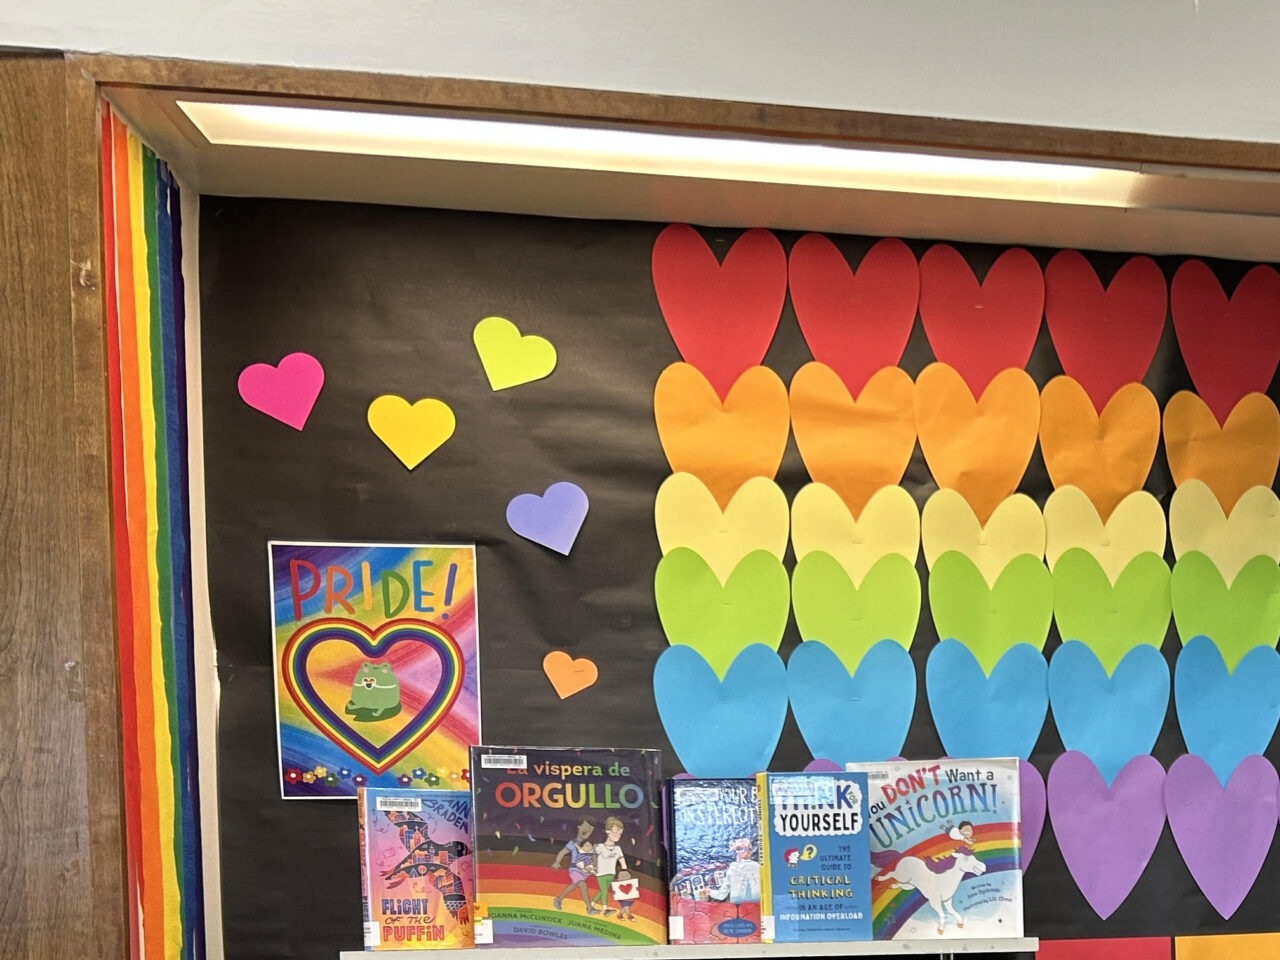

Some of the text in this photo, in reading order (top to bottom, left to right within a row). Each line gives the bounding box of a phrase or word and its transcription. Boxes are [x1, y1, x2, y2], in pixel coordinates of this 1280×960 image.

[289, 559, 458, 621] PRIDE!
[608, 762, 630, 776] de
[880, 764, 994, 805] DON'T Want a
[495, 781, 644, 809] ORGULLO
[869, 800, 887, 818] ou
[422, 799, 469, 834] BRADEN
[780, 812, 859, 832] YOURSELF
[839, 845, 851, 853] THE
[820, 854, 851, 862] ULTIMATE
[821, 863, 852, 871] GUIDE TO
[790, 875, 851, 886] CRITICAL
[788, 888, 853, 899] THINKING
[834, 903, 844, 911] OF
[384, 916, 400, 925] OF
[780, 911, 864, 921] INFORMATION OVERLOAD
[513, 926, 568, 940] DAVID BOWLES
